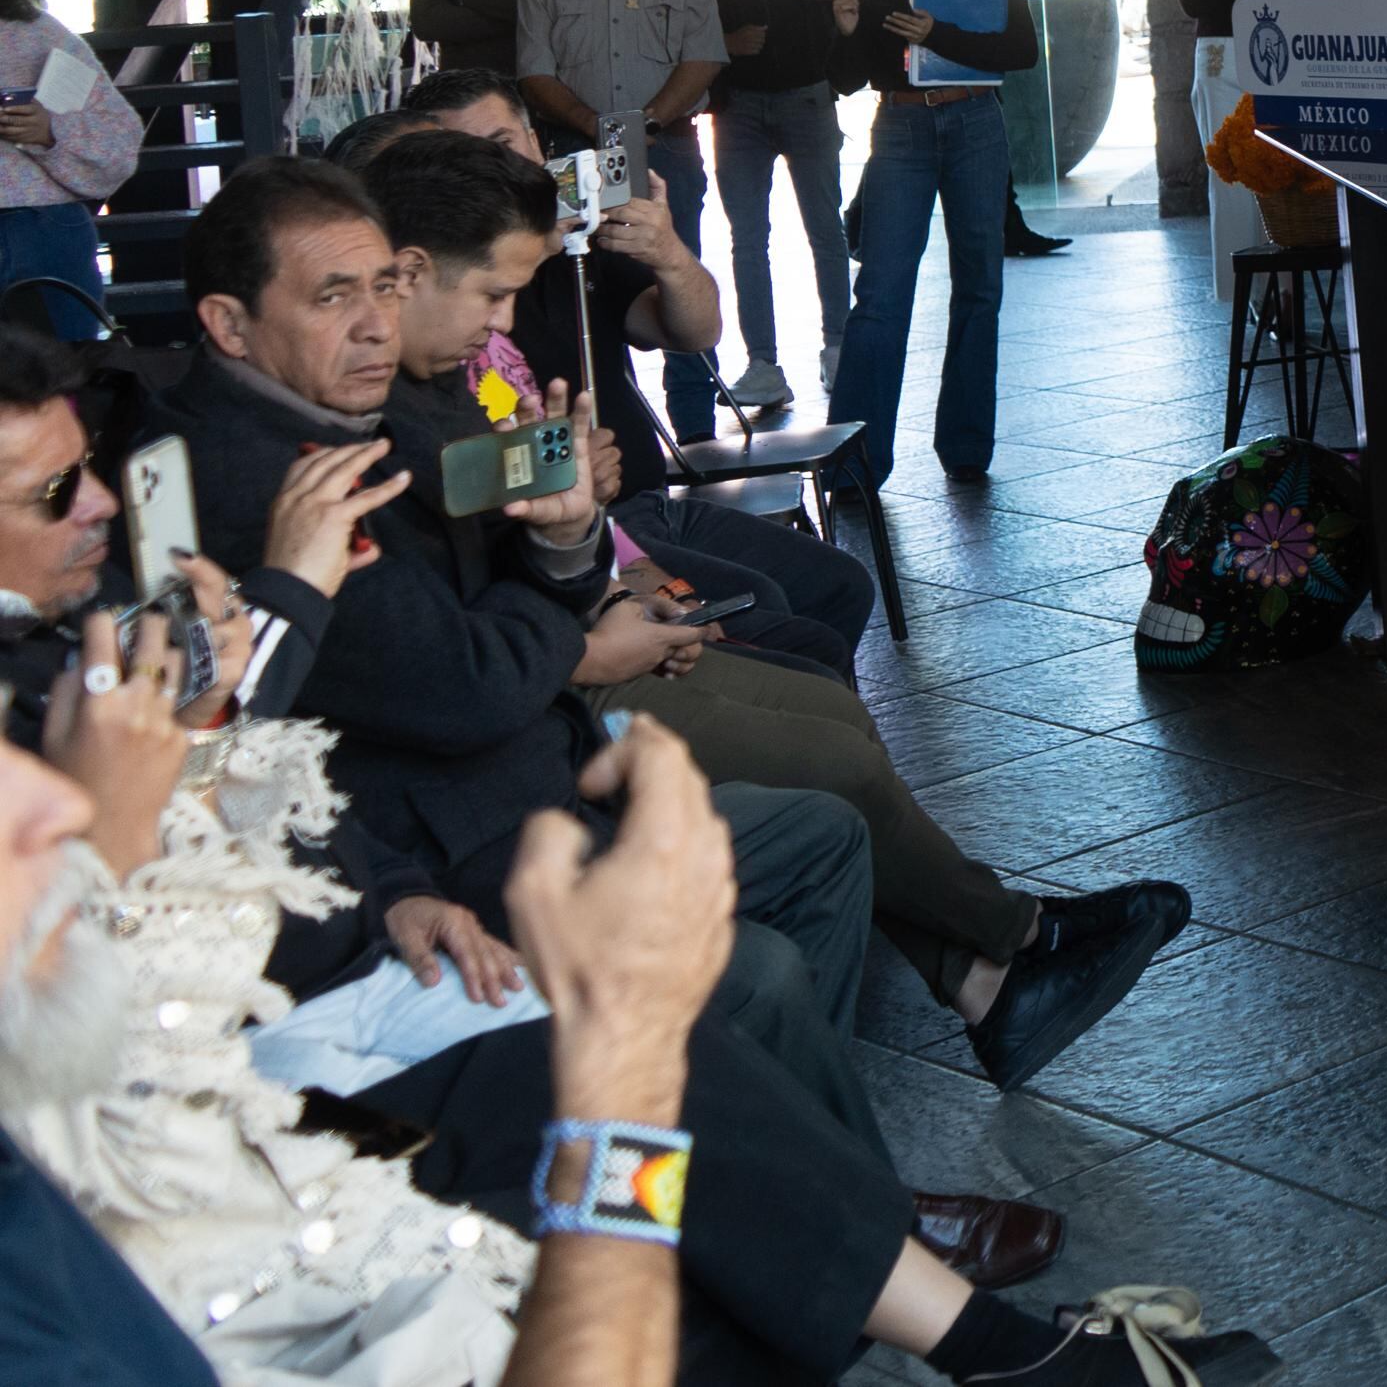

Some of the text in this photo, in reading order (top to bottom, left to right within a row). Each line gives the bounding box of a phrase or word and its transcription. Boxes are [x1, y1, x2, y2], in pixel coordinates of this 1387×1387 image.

[1306, 63, 1347, 73] GOBIERNO
[1348, 65, 1358, 74] DE
[1361, 65, 1371, 74] LA
[1298, 101, 1370, 125] MÉXICO
